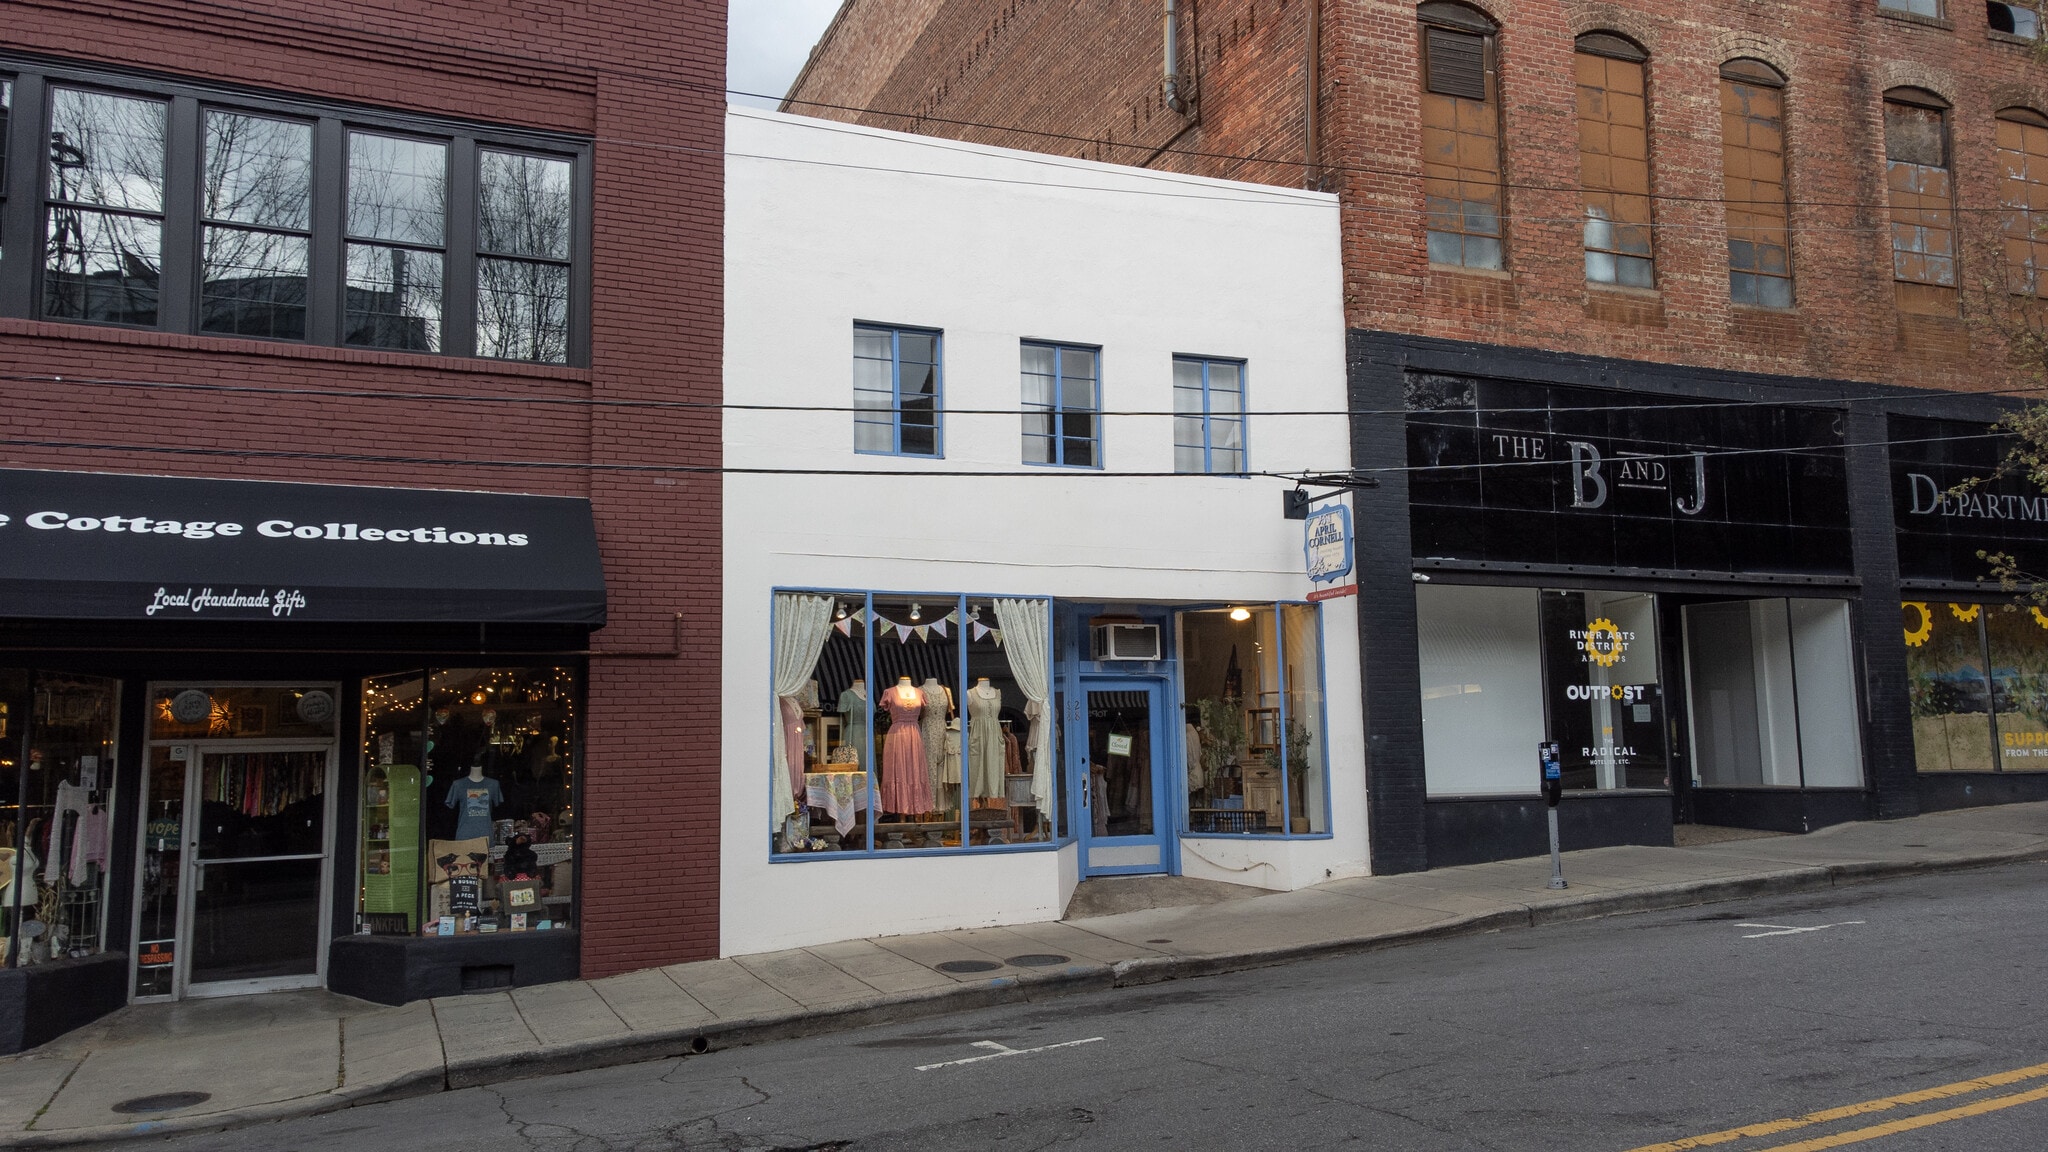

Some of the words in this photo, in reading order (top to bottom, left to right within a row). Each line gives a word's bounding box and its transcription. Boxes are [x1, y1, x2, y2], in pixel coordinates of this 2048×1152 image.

[1492, 434, 1546, 460] THE
[1566, 440, 1607, 509] B
[1619, 460, 1666, 482] AND
[1676, 451, 1708, 515] J
[1907, 473, 2048, 522] DEPARTME
[25, 511, 243, 540] Cottage
[257, 519, 529, 547] Collections
[1314, 523, 1337, 538] APRIL
[1309, 532, 1343, 549] CORNELL
[146, 587, 190, 616] Local
[191, 588, 270, 614] Handmade
[271, 588, 307, 616] Gifts
[1569, 630, 1602, 640] RIVER
[1607, 631, 1635, 640] ARTS
[1577, 641, 1629, 650] DISTRICT
[1581, 654, 1626, 663] ARTISTS
[1566, 684, 1644, 700] OUTPOST
[1582, 747, 1637, 757] RADICAL
[2005, 749, 2029, 757] FROM
[2032, 748, 2048, 757] THE
[150, 944, 159, 953] NO
